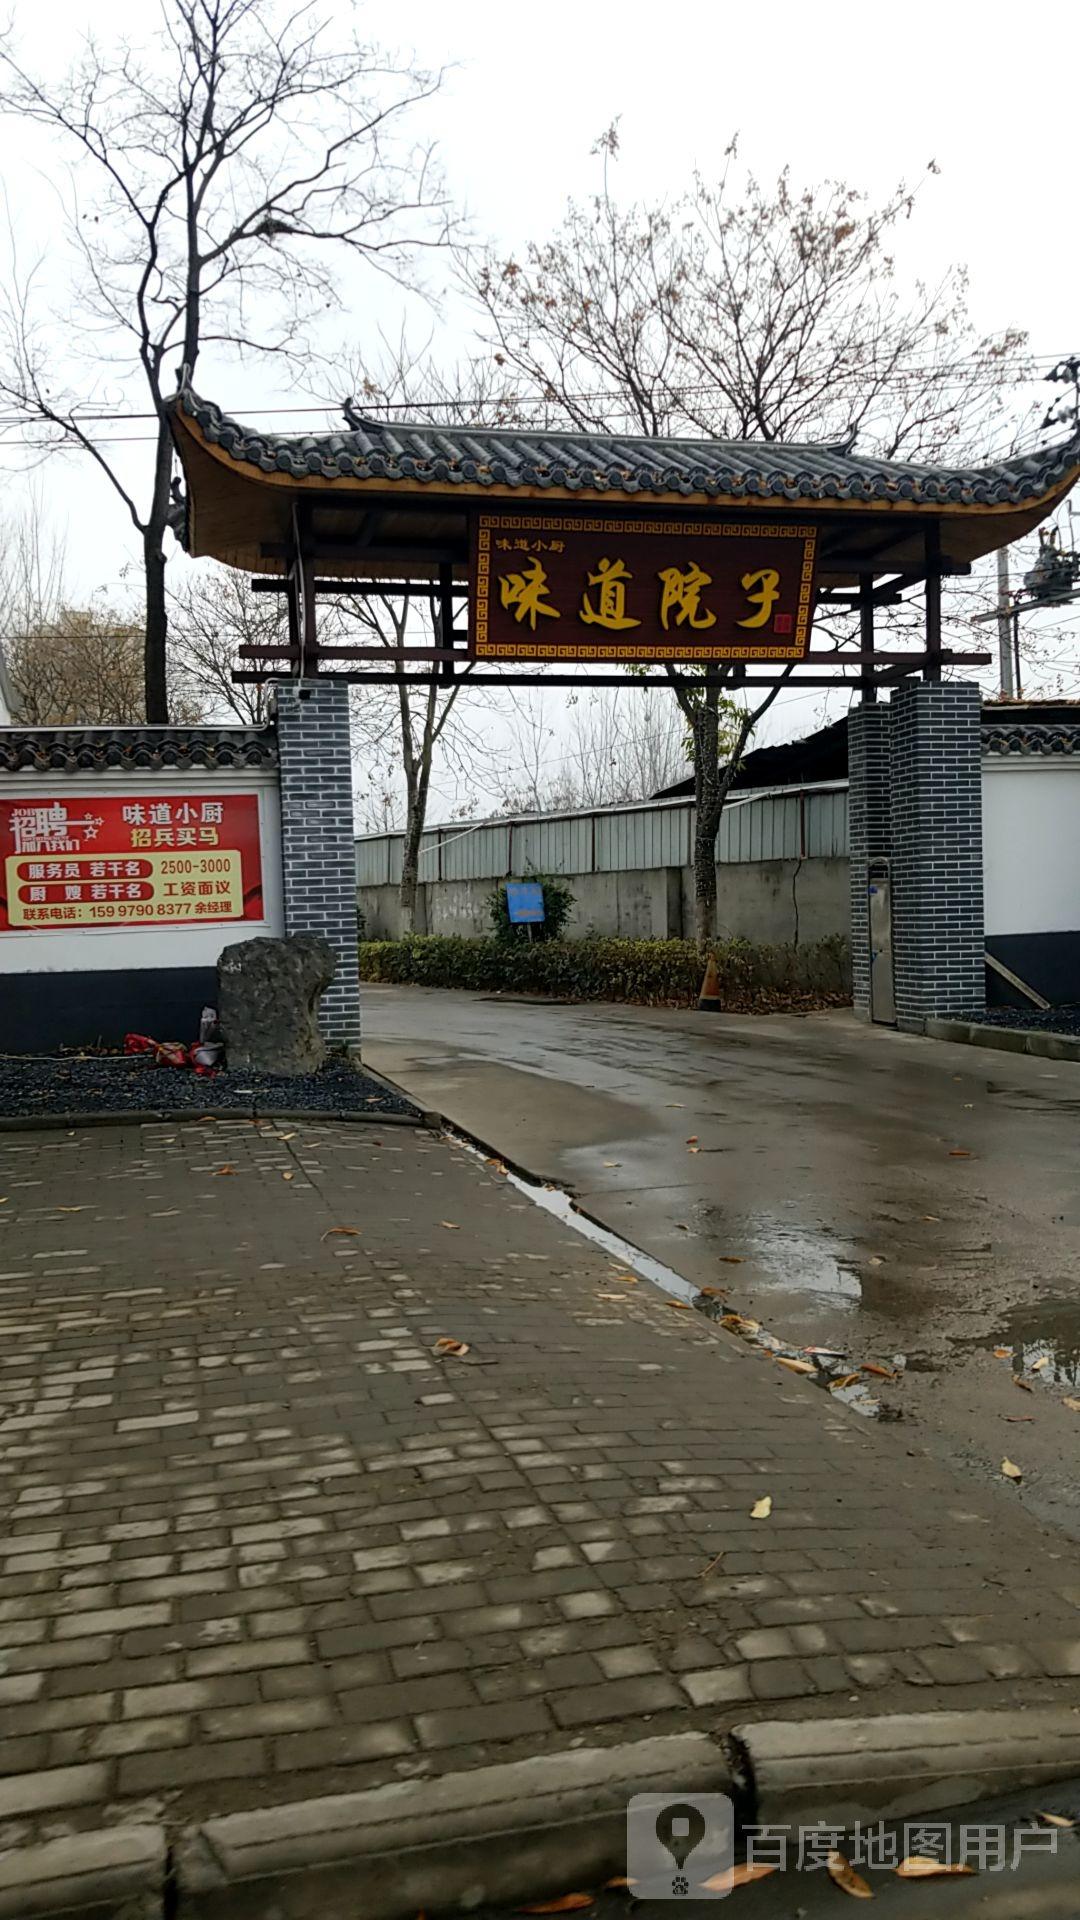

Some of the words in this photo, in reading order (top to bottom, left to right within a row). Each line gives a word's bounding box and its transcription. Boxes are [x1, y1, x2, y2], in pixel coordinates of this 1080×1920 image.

[496, 538, 566, 553] 味道小厨
[498, 556, 781, 631] 味道院子
[122, 802, 224, 825] 味道小厨
[9, 802, 68, 854] 招聘
[131, 827, 219, 848] 招兵买马
[28, 863, 81, 879] 服务员
[90, 861, 141, 877] 若干名
[160, 858, 231, 875] 2500-3000
[91, 883, 142, 899] 若干名
[163, 880, 231, 897] 工资面议
[194, 901, 233, 914] 余经理
